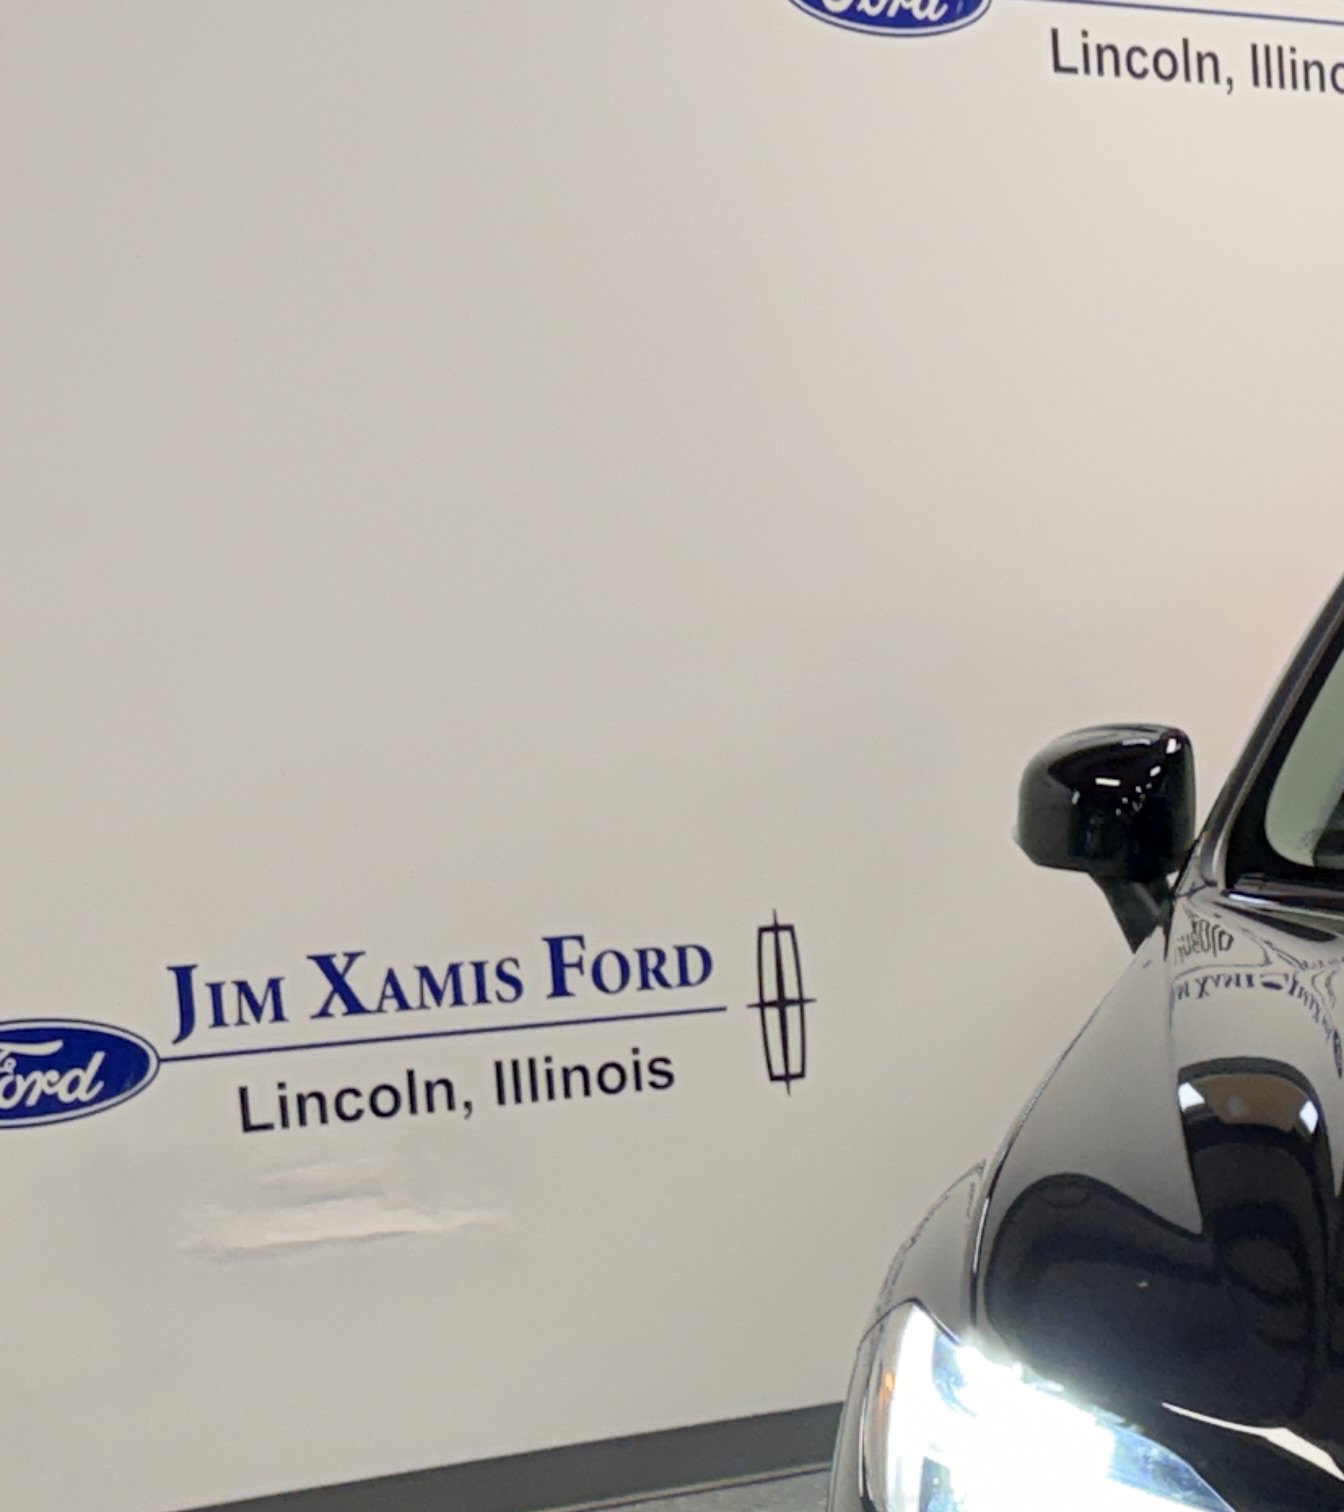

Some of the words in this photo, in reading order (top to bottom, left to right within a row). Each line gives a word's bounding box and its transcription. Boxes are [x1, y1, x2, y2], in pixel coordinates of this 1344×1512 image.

[1050, 27, 1233, 95] Lincoln,
[166, 964, 289, 1044] JIM
[307, 951, 525, 1020] XAMIS
[541, 934, 713, 999] FORD
[238, 1068, 473, 1134] Lincoln,
[494, 1047, 675, 1106] Illinois
